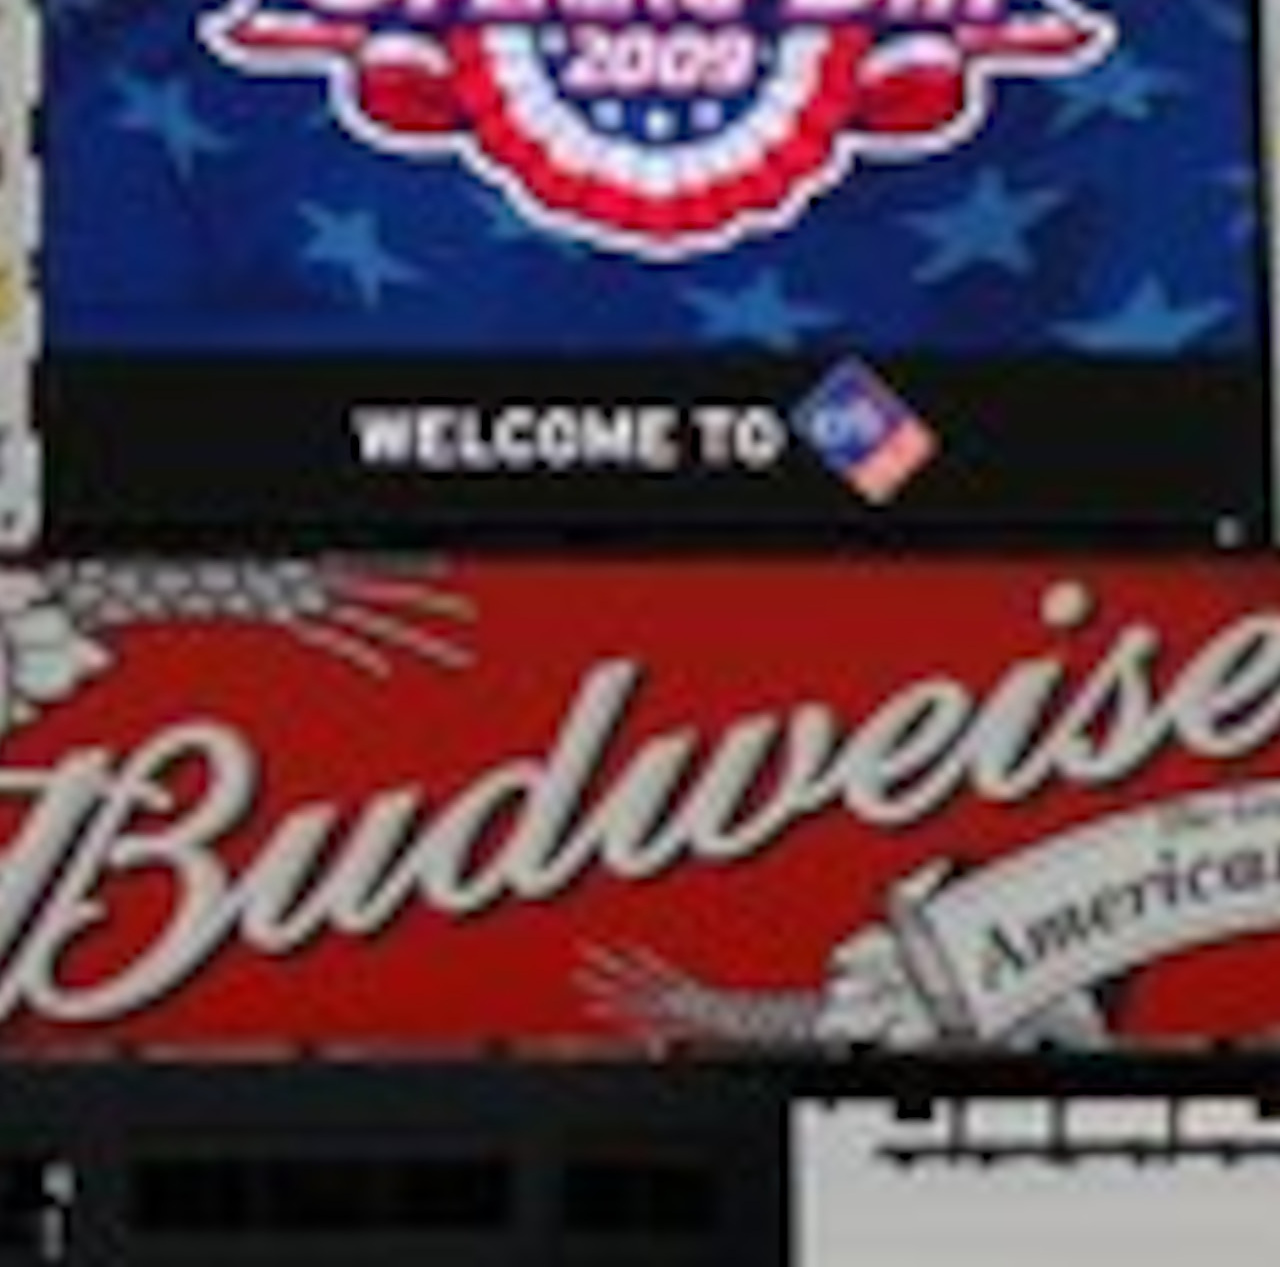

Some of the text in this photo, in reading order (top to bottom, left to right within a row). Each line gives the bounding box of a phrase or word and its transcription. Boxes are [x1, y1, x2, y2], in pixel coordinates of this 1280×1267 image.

[558, 27, 756, 97] 2009
[350, 405, 680, 471] WELCOME
[692, 405, 786, 469] TO
